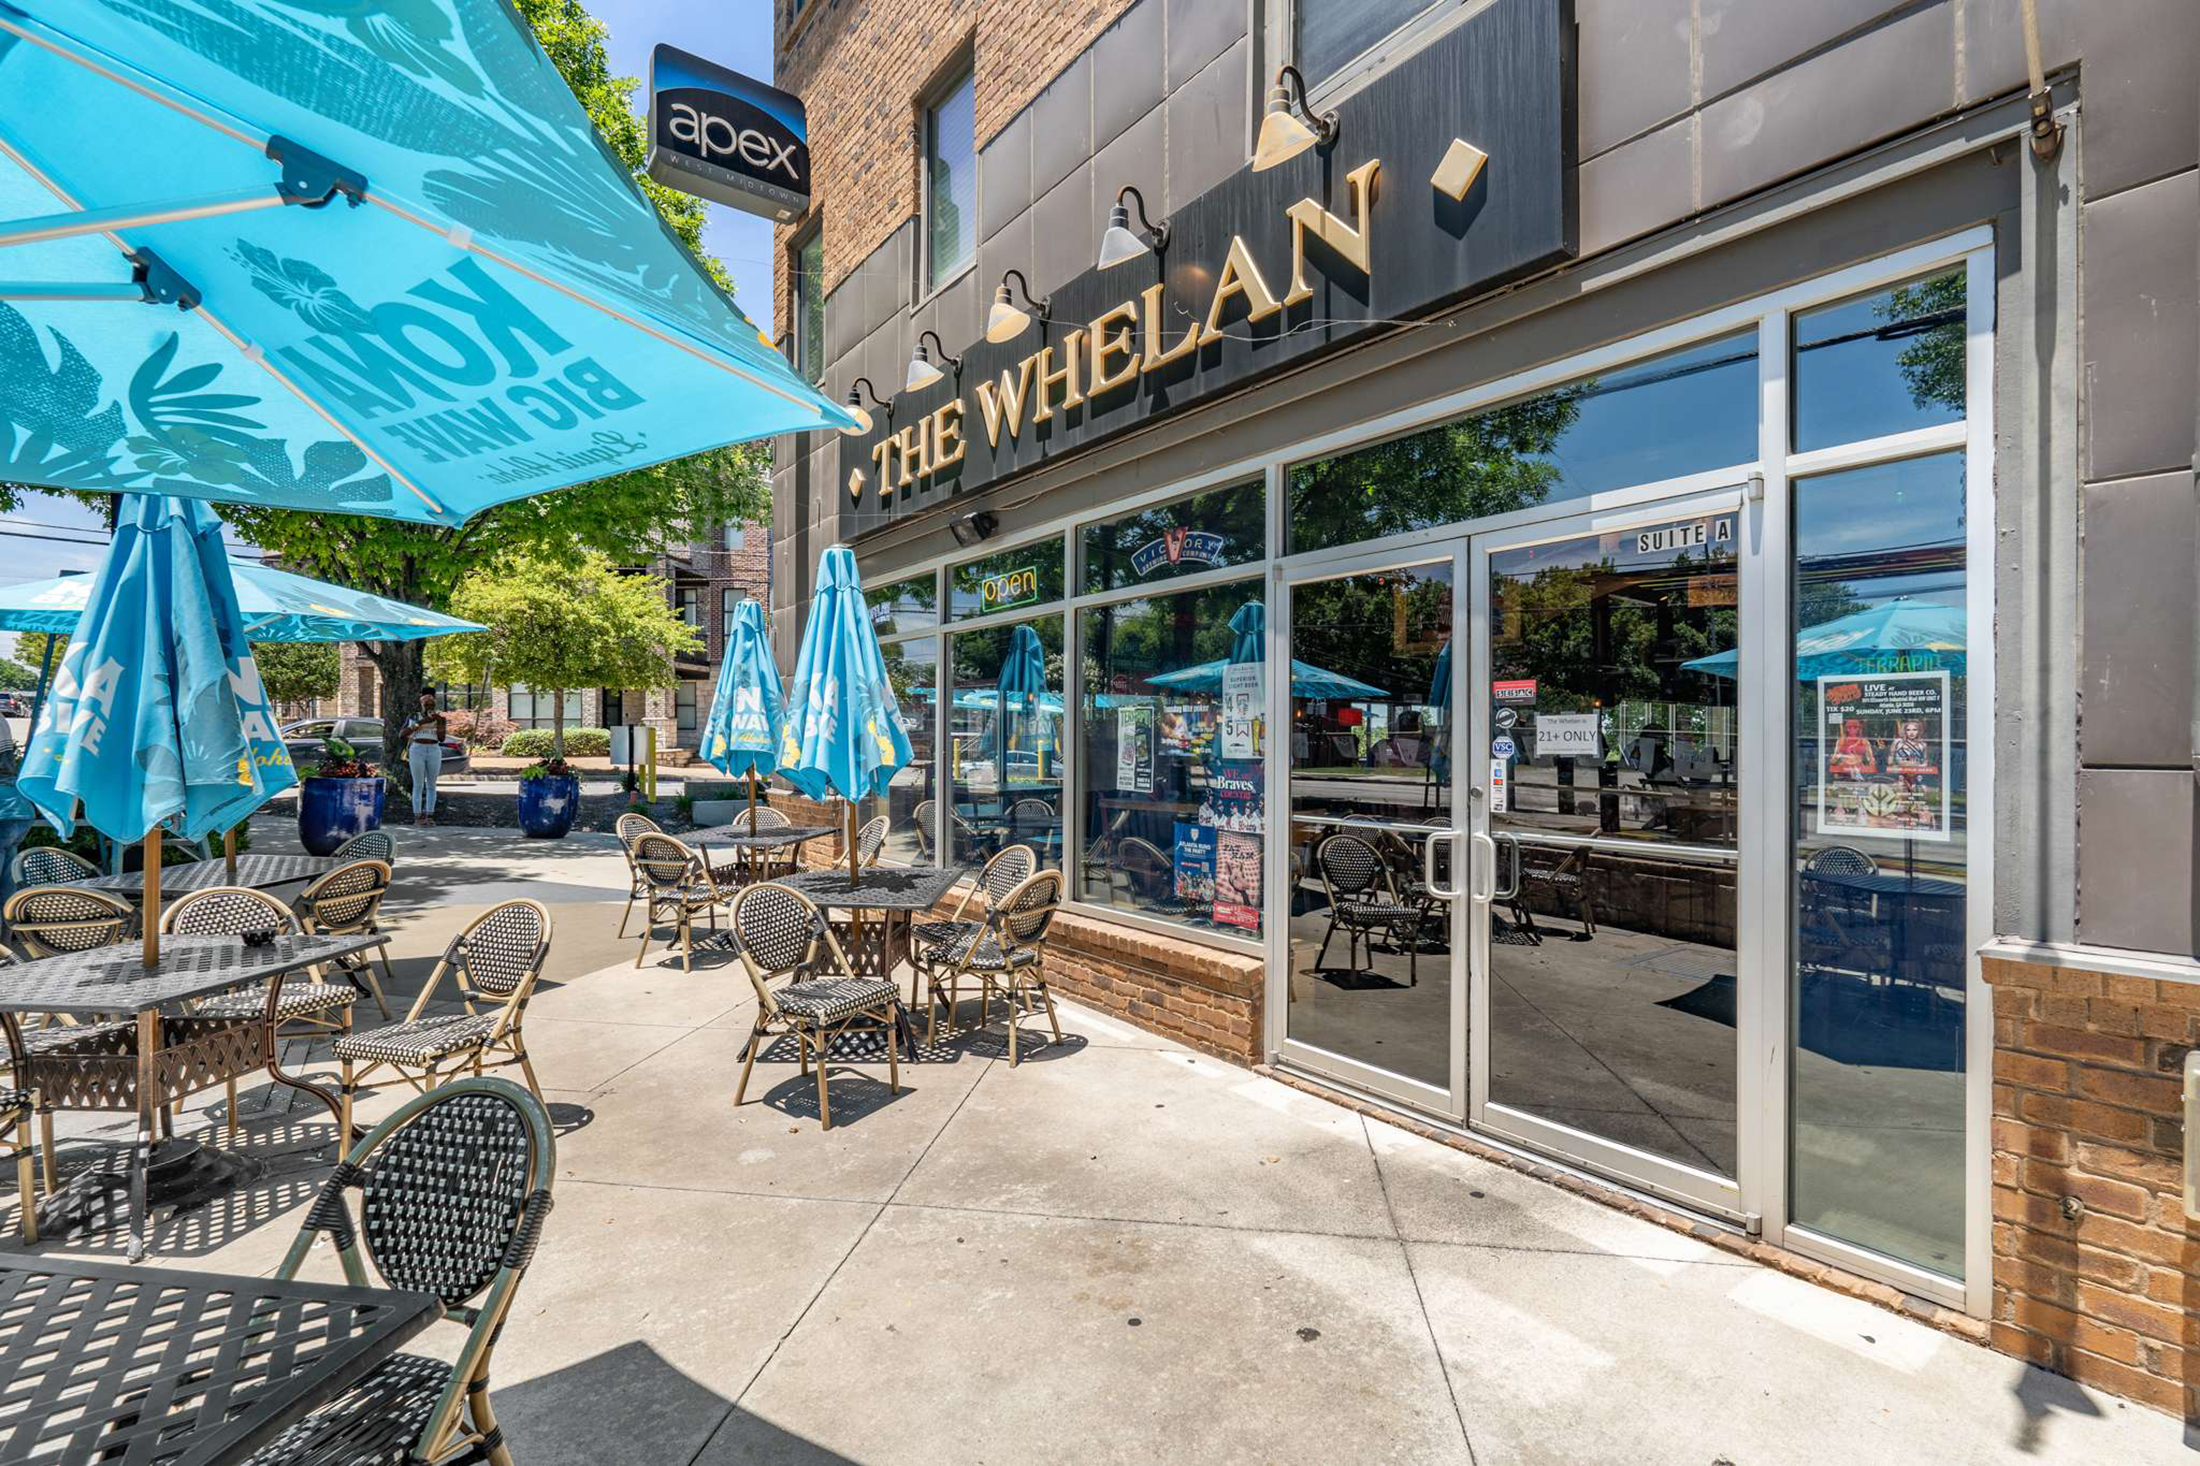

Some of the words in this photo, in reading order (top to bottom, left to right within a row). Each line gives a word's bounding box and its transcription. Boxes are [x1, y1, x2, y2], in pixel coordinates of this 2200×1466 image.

[669, 103, 799, 180] apex
[670, 154, 712, 174] WEST
[726, 174, 799, 204] MIDTOWN
[872, 398, 967, 496] THE
[976, 158, 1380, 448] WHELAN
[1640, 525, 1704, 552] SUITE
[1718, 522, 1729, 540] A
[985, 571, 1034, 602] open
[1494, 741, 1513, 751] VSC
[1538, 730, 1560, 742] 21+
[1563, 730, 1597, 742] ONLY
[1217, 775, 1254, 791] Braves
